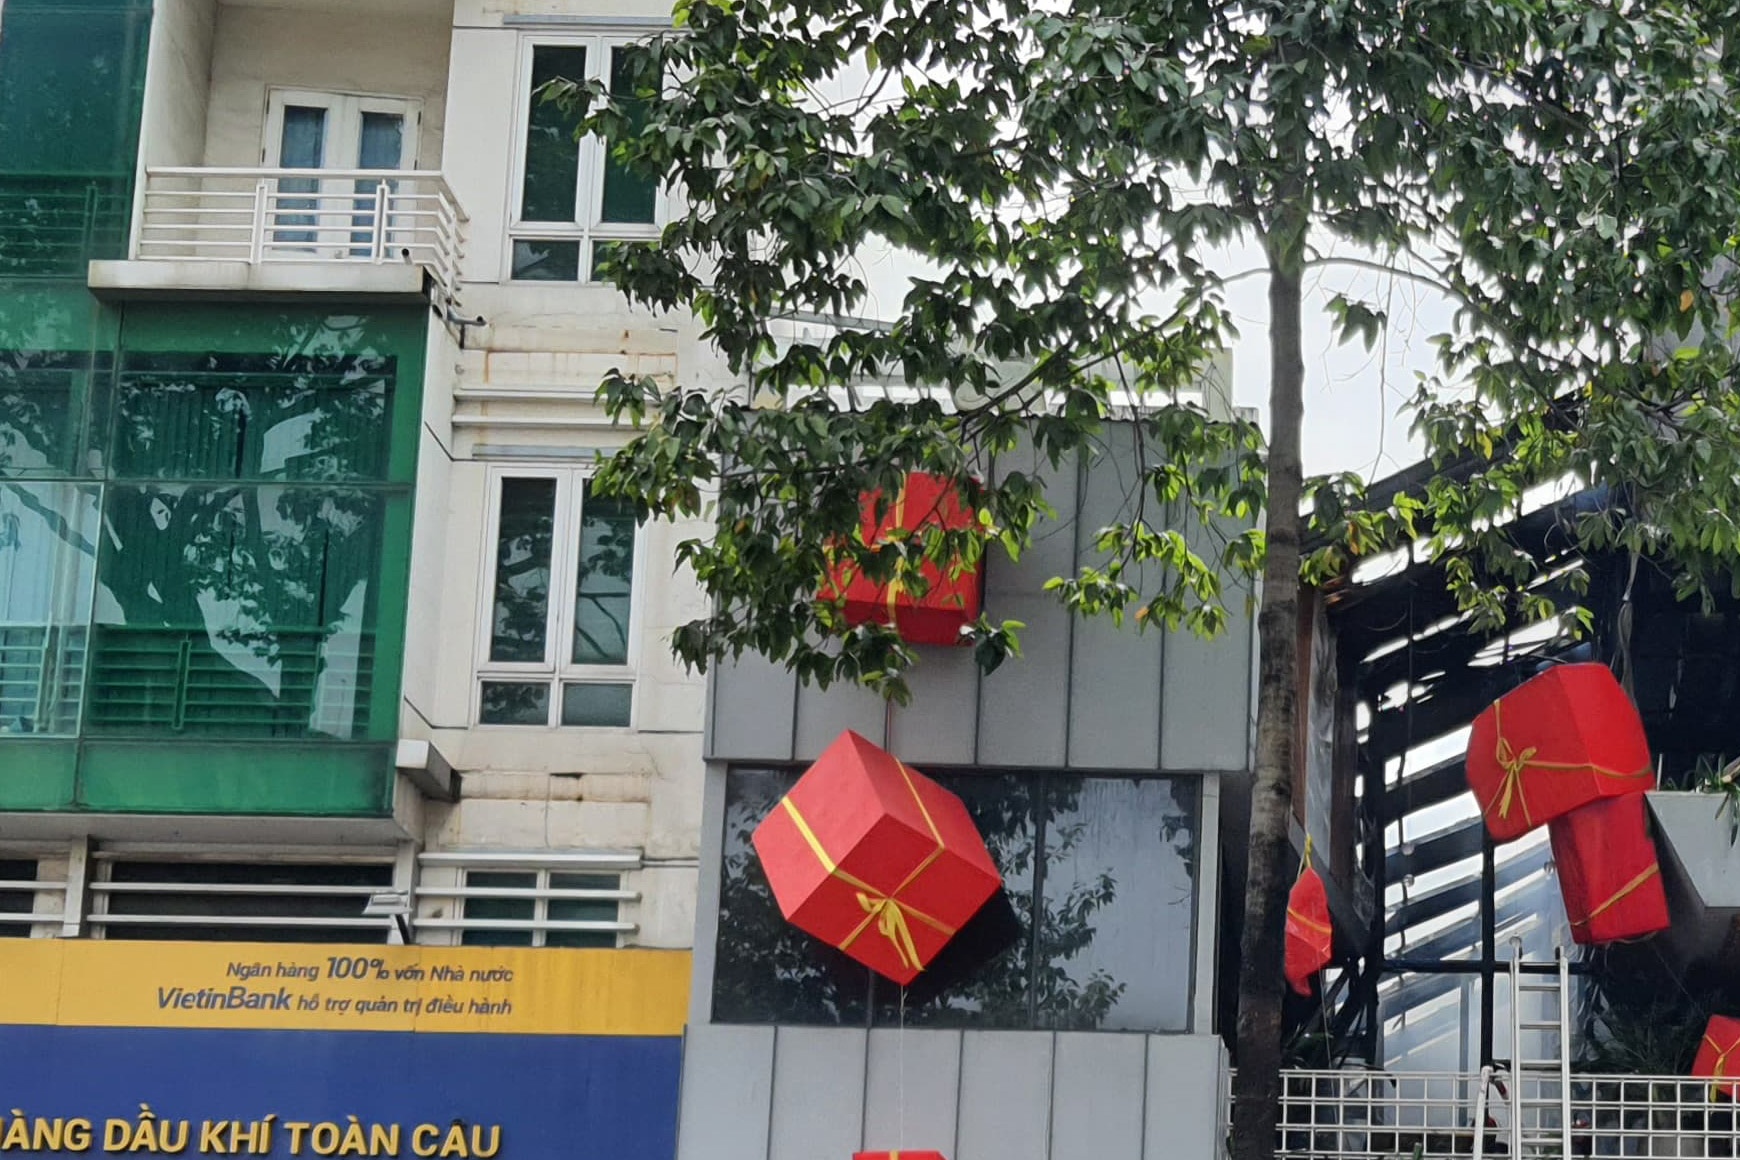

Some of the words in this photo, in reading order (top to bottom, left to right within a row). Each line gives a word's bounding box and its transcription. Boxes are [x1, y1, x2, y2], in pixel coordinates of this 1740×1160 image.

[226, 962, 272, 981] Ngân
[275, 962, 319, 981] hàng
[326, 957, 389, 980] 100%
[429, 965, 464, 981] Nhà
[157, 986, 292, 1010] VietinBank
[468, 997, 512, 1015] hành
[0, 1108, 92, 1151] ÀNG
[103, 1102, 189, 1153] DẦU
[200, 1113, 277, 1154] KHÍ
[284, 1115, 400, 1156] TOÀN
